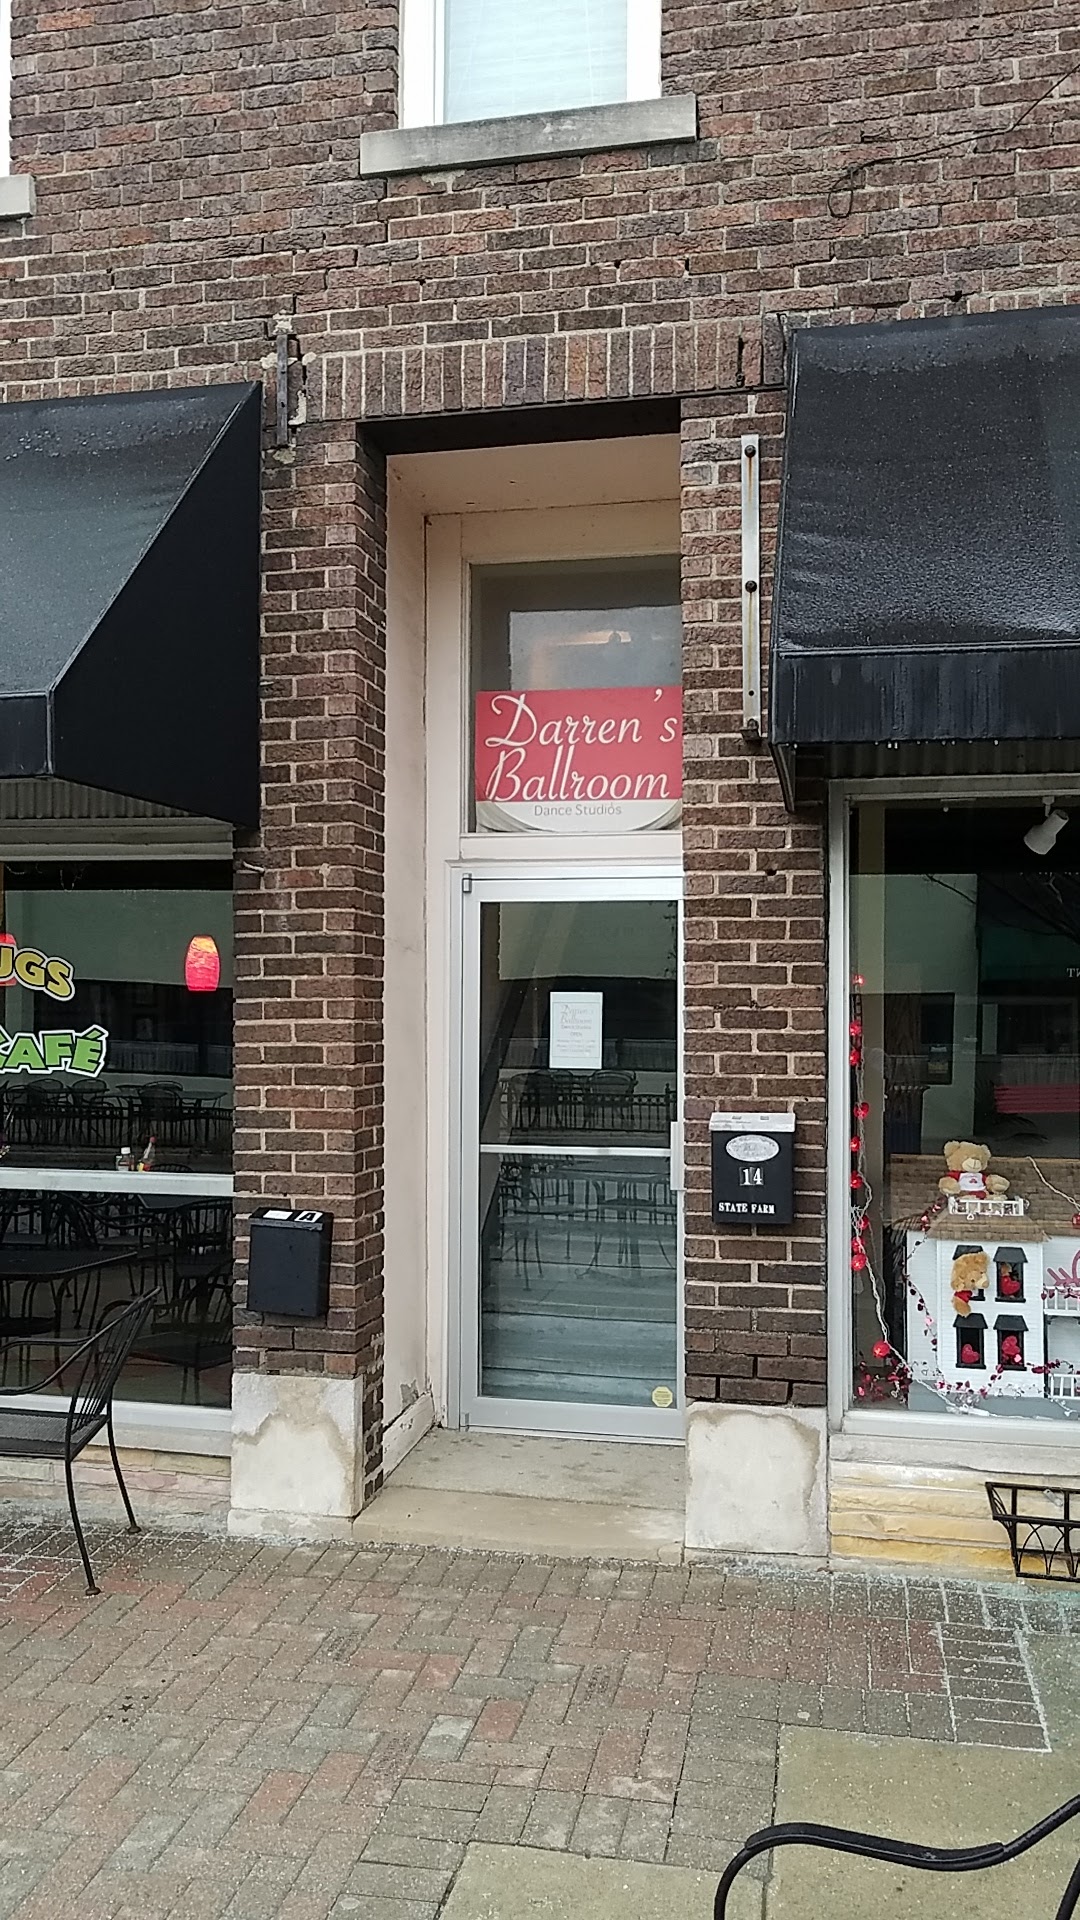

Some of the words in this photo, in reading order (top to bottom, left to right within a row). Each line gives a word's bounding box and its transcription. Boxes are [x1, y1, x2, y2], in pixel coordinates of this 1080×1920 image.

[485, 688, 679, 747] Darren's
[485, 744, 670, 801] Ballroom
[534, 804, 573, 817] Dance
[575, 803, 622, 816] Studios
[743, 1167, 763, 1186] 14
[718, 1202, 748, 1213] STATE
[751, 1204, 775, 1214] FARM
[298, 1212, 317, 1221] A
